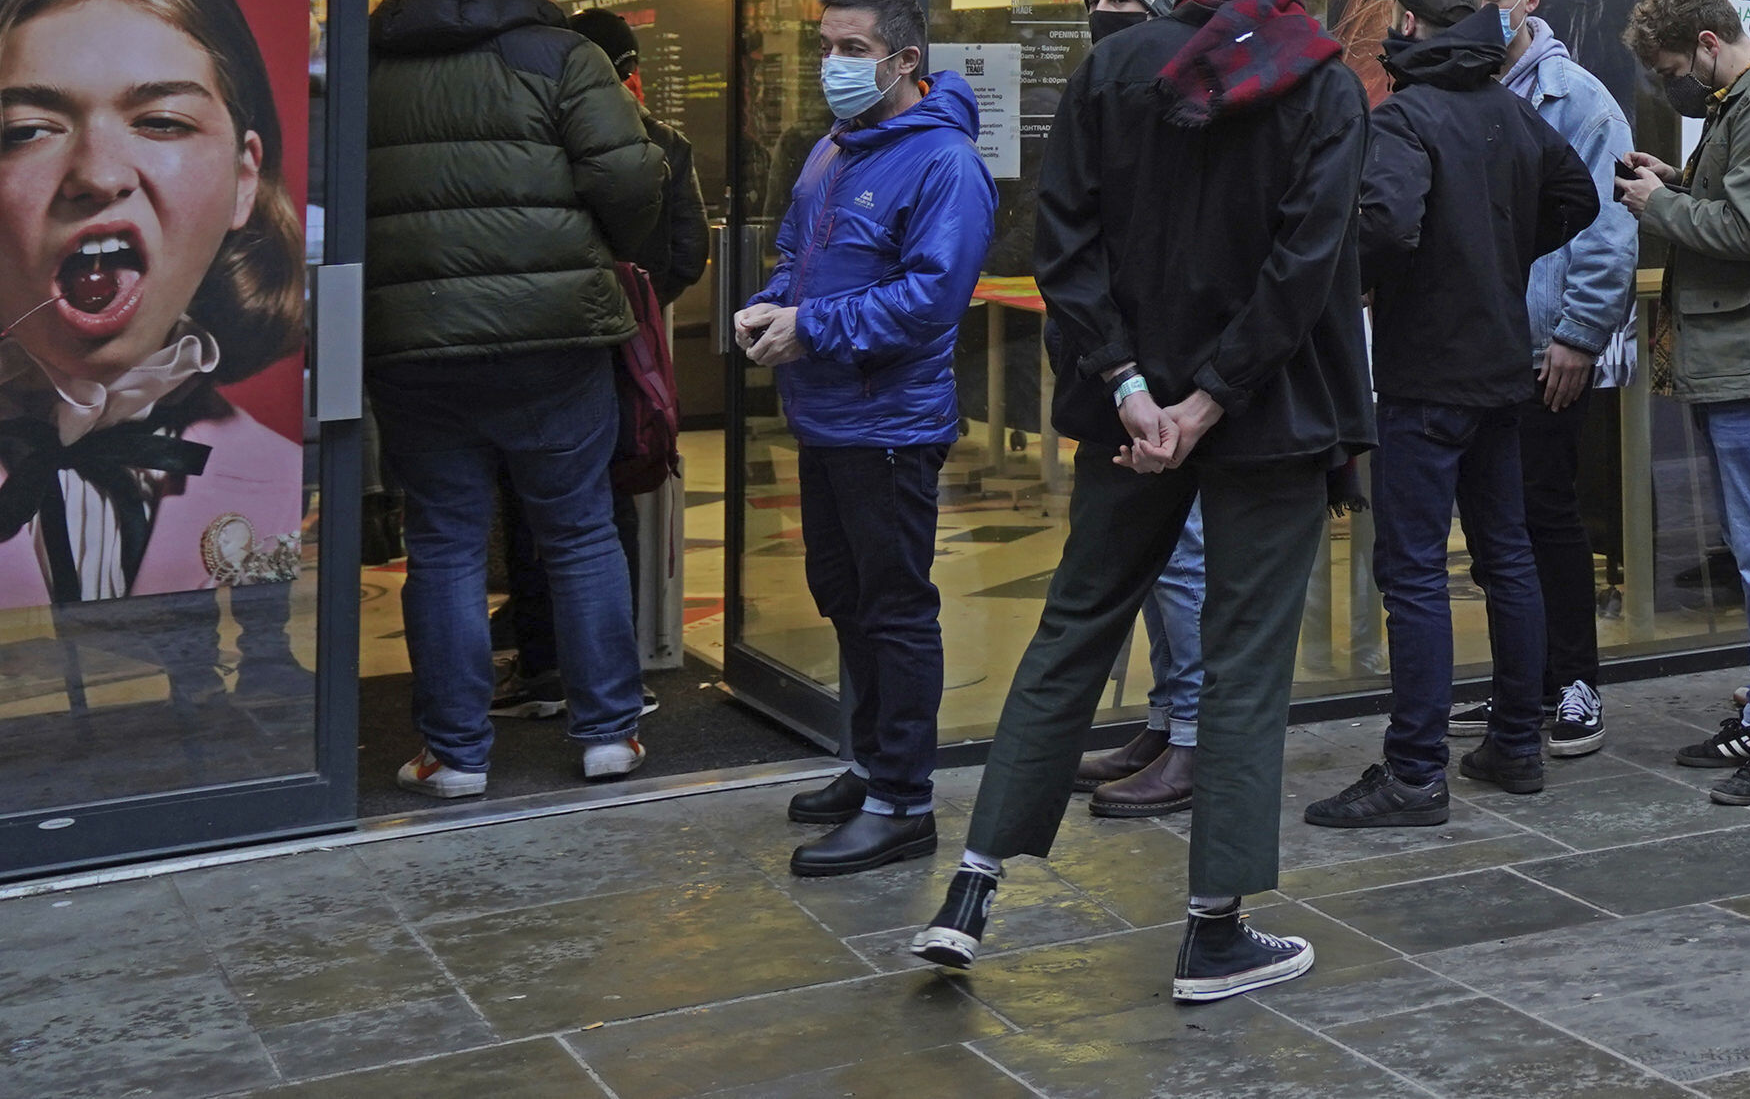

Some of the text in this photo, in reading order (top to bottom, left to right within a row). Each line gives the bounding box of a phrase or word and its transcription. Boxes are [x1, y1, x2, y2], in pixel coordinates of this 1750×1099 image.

[1049, 30, 1079, 39] OPENING
[1041, 44, 1070, 52] Saturday
[965, 58, 985, 66] ROUGH
